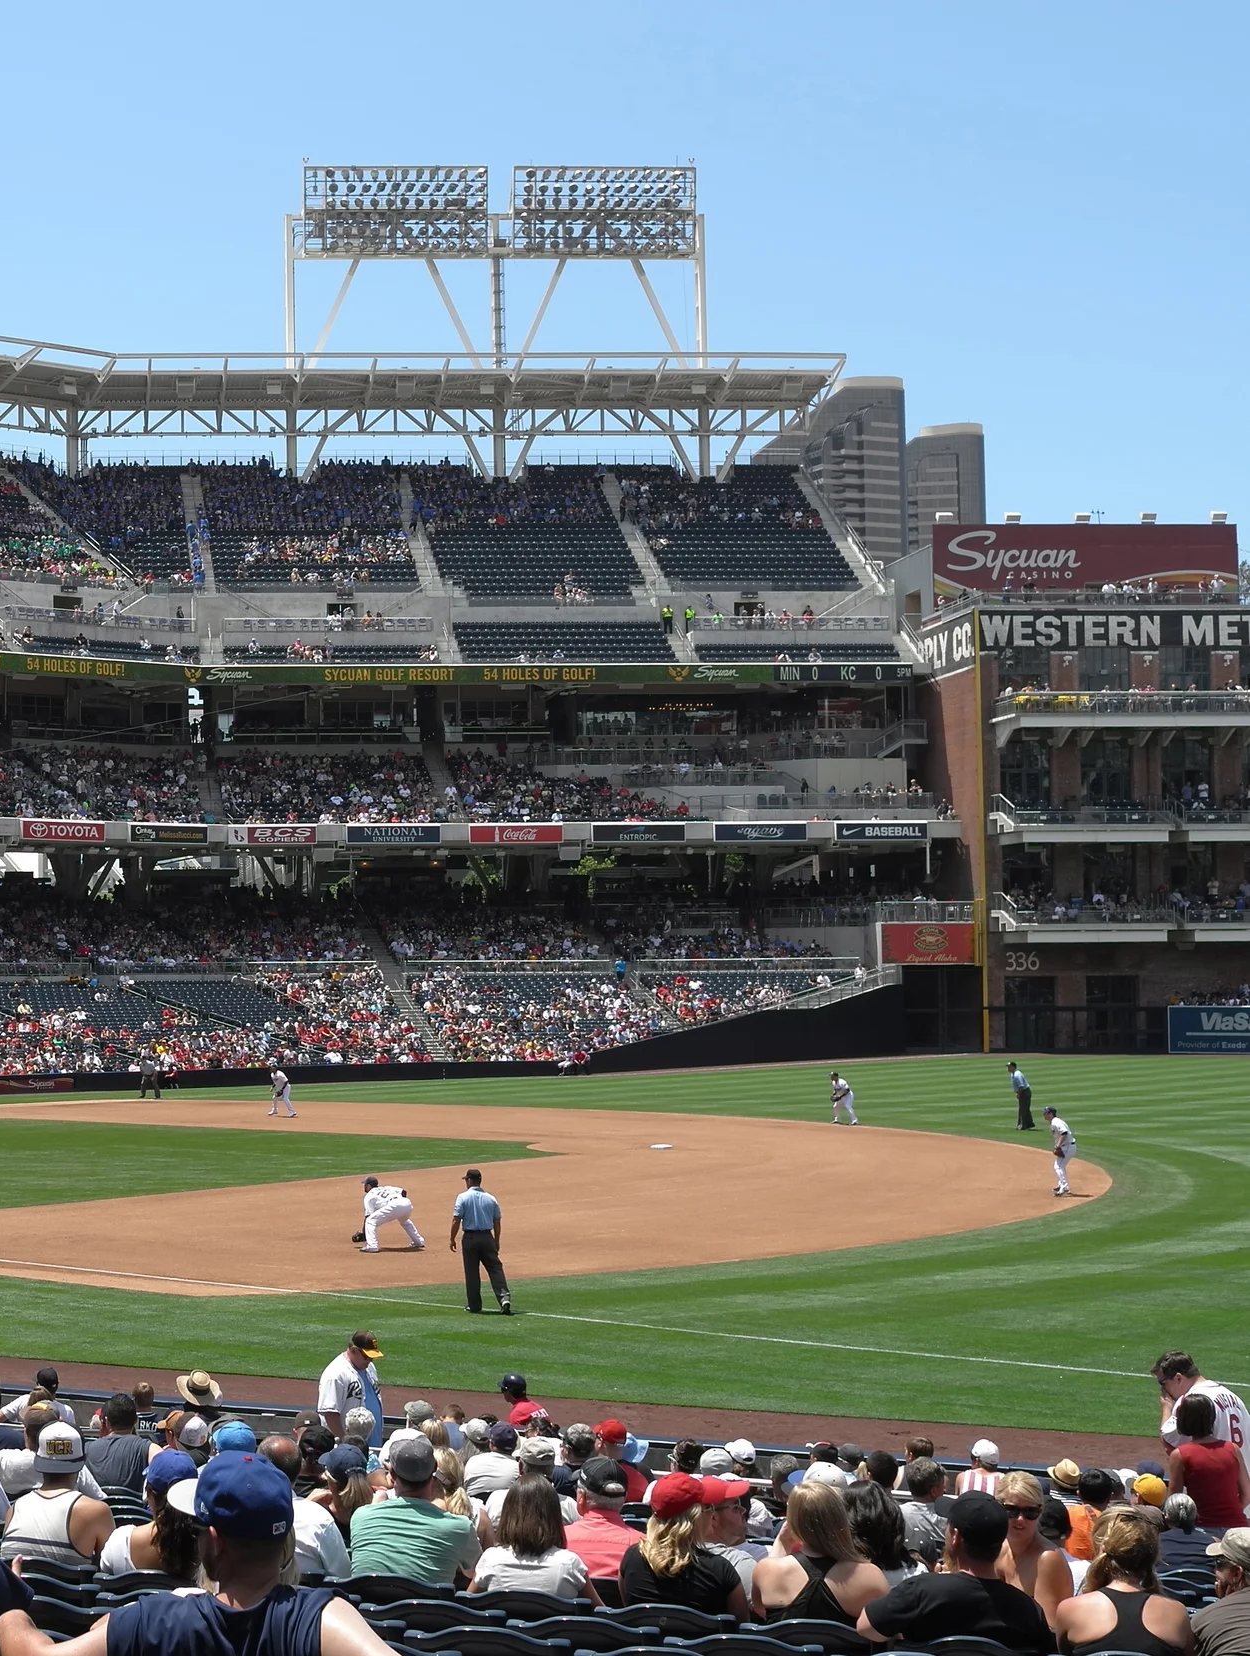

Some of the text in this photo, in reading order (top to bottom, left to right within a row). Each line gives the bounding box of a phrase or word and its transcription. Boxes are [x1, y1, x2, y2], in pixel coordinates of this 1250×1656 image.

[947, 530, 1081, 581] Sycuan
[1008, 571, 1072, 579] CASINO
[979, 615, 1161, 647] WESTERN
[26, 658, 126, 677] 54 HOLES OF GOLF!
[324, 668, 455, 681] SYCUAN GOLF RESORT
[483, 667, 596, 681] 54 HOLES OF GOLF!
[693, 665, 739, 681] Sycuan
[780, 666, 911, 680] MIN 0 KC 0 5PM
[206, 667, 252, 683] Sycuan
[49, 825, 98, 838] TOYOTA
[254, 827, 312, 837] BCS
[363, 827, 425, 836] NATIONAL
[864, 826, 922, 837] BASEBALL
[1005, 951, 1040, 971] 336
[1177, 1041, 1210, 1049] Provider
[1212, 1041, 1220, 1049] of
[1230, 1413, 1244, 1448] 6
[46, 1439, 74, 1456] UCR
